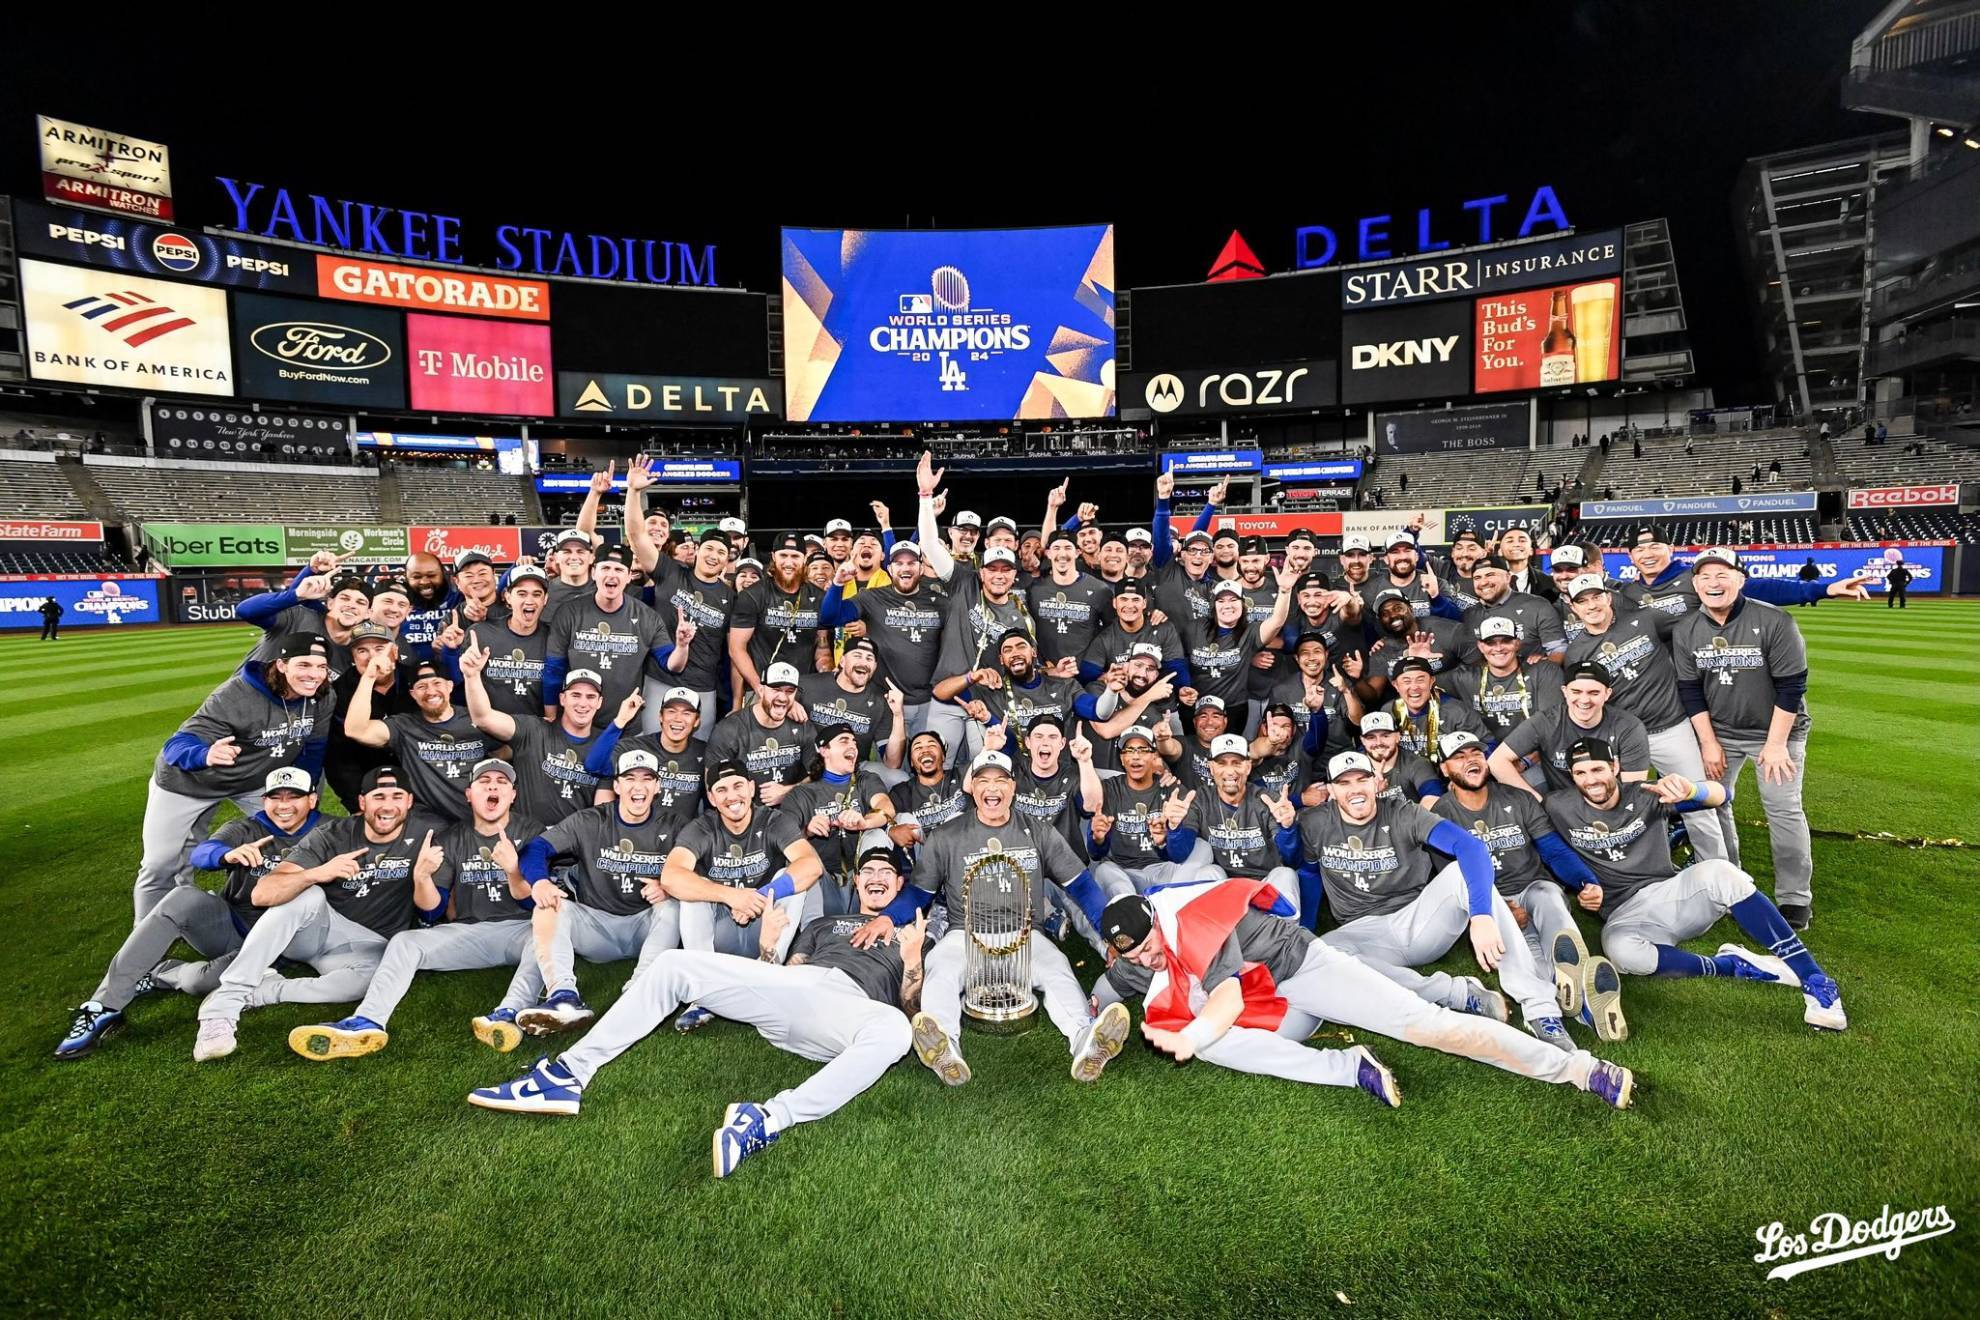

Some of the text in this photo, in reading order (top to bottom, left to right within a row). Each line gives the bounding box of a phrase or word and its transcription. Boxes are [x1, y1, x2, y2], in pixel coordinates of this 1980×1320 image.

[46, 126, 162, 163] ARMITRON
[111, 169, 161, 183] sport
[56, 179, 161, 209] ARMITRON
[110, 200, 160, 215] WATCHES
[215, 176, 718, 286] YANKEE STADIUM
[1296, 185, 1571, 269] DELTA
[48, 223, 125, 250] PEPSI
[156, 244, 197, 260] PEPSI
[226, 255, 289, 276] PEPSI
[1346, 244, 1615, 304] STARR INSURANCE
[333, 266, 540, 312] GATORADE
[1481, 300, 1527, 318] This
[889, 314, 1011, 326] WORLD SERIES
[1482, 316, 1536, 336] Bud's
[277, 327, 368, 364] Ford
[869, 325, 1031, 352] CHAMPIONS
[1482, 337, 1516, 353] For
[912, 352, 989, 361] 20 24
[1352, 335, 1460, 370] DKNY
[35, 351, 228, 382] BANK OF AMERICA
[418, 350, 544, 382] T Mobile
[1481, 354, 1524, 370] You.
[279, 369, 370, 385] BuyFordNow.com
[939, 352, 966, 391] LA
[1199, 368, 1308, 408] razr
[626, 383, 770, 412] DELTA
[216, 425, 295, 441] New York Yankees
[1442, 437, 1496, 448] THE BOSS
[1286, 488, 1351, 498] TOYOTA TERRACE
[1851, 488, 1955, 507] Reebok
[1606, 504, 1644, 512] FANDUEL
[1676, 502, 1718, 510] FANDUEL
[1752, 498, 1797, 507] FANDUEL
[1239, 521, 1278, 530] TOYOTA
[1484, 519, 1541, 531] CLEAR
[288, 528, 338, 539] Morningside
[219, 536, 280, 554] Eats
[382, 538, 405, 546] Circle
[1749, 564, 1837, 578] CHAMPNS
[74, 601, 149, 612] CHAMPIONS
[677, 589, 725, 620] WORLD SERIES
[1040, 601, 1091, 611] WORLD SERIES
[188, 605, 235, 621] Stub
[887, 609, 940, 618] WORLD SERIES
[1039, 608, 1090, 620] CHAMPIONS
[1057, 619, 1067, 634] LA
[575, 631, 639, 644] WORLD SERIES
[910, 629, 921, 642] LA
[574, 640, 639, 654] CHAMPIONS
[1617, 635, 1650, 656] SERIES
[1725, 648, 1762, 657] SERIES
[488, 659, 519, 670] WORLD
[600, 652, 612, 669] LA
[1622, 666, 1639, 681] LA
[1719, 668, 1733, 685] LA
[514, 679, 527, 695] LA
[813, 703, 871, 725] WORLD SERIES
[418, 740, 484, 752] WORLD SERIES
[747, 747, 801, 761] WORLD SERIES
[446, 761, 460, 778] LA
[542, 760, 599, 786] CHAMPION
[675, 773, 701, 782] SERIES
[772, 767, 783, 782] LA
[561, 781, 573, 798] LA
[661, 790, 674, 806] LA
[1016, 794, 1044, 803] WORLD
[912, 803, 942, 816] WORLD
[1209, 826, 1262, 838] WORLD SERIES
[632, 854, 667, 864] SERIES
[1229, 850, 1243, 868] LA
[1323, 847, 1396, 859] WORLD SERIES
[1608, 848, 1626, 862] LA
[462, 862, 491, 871] WORD
[1321, 856, 1399, 872] CHAMPIONS
[620, 873, 634, 893] LA
[1355, 872, 1369, 892] LA
[487, 882, 501, 901] LA
